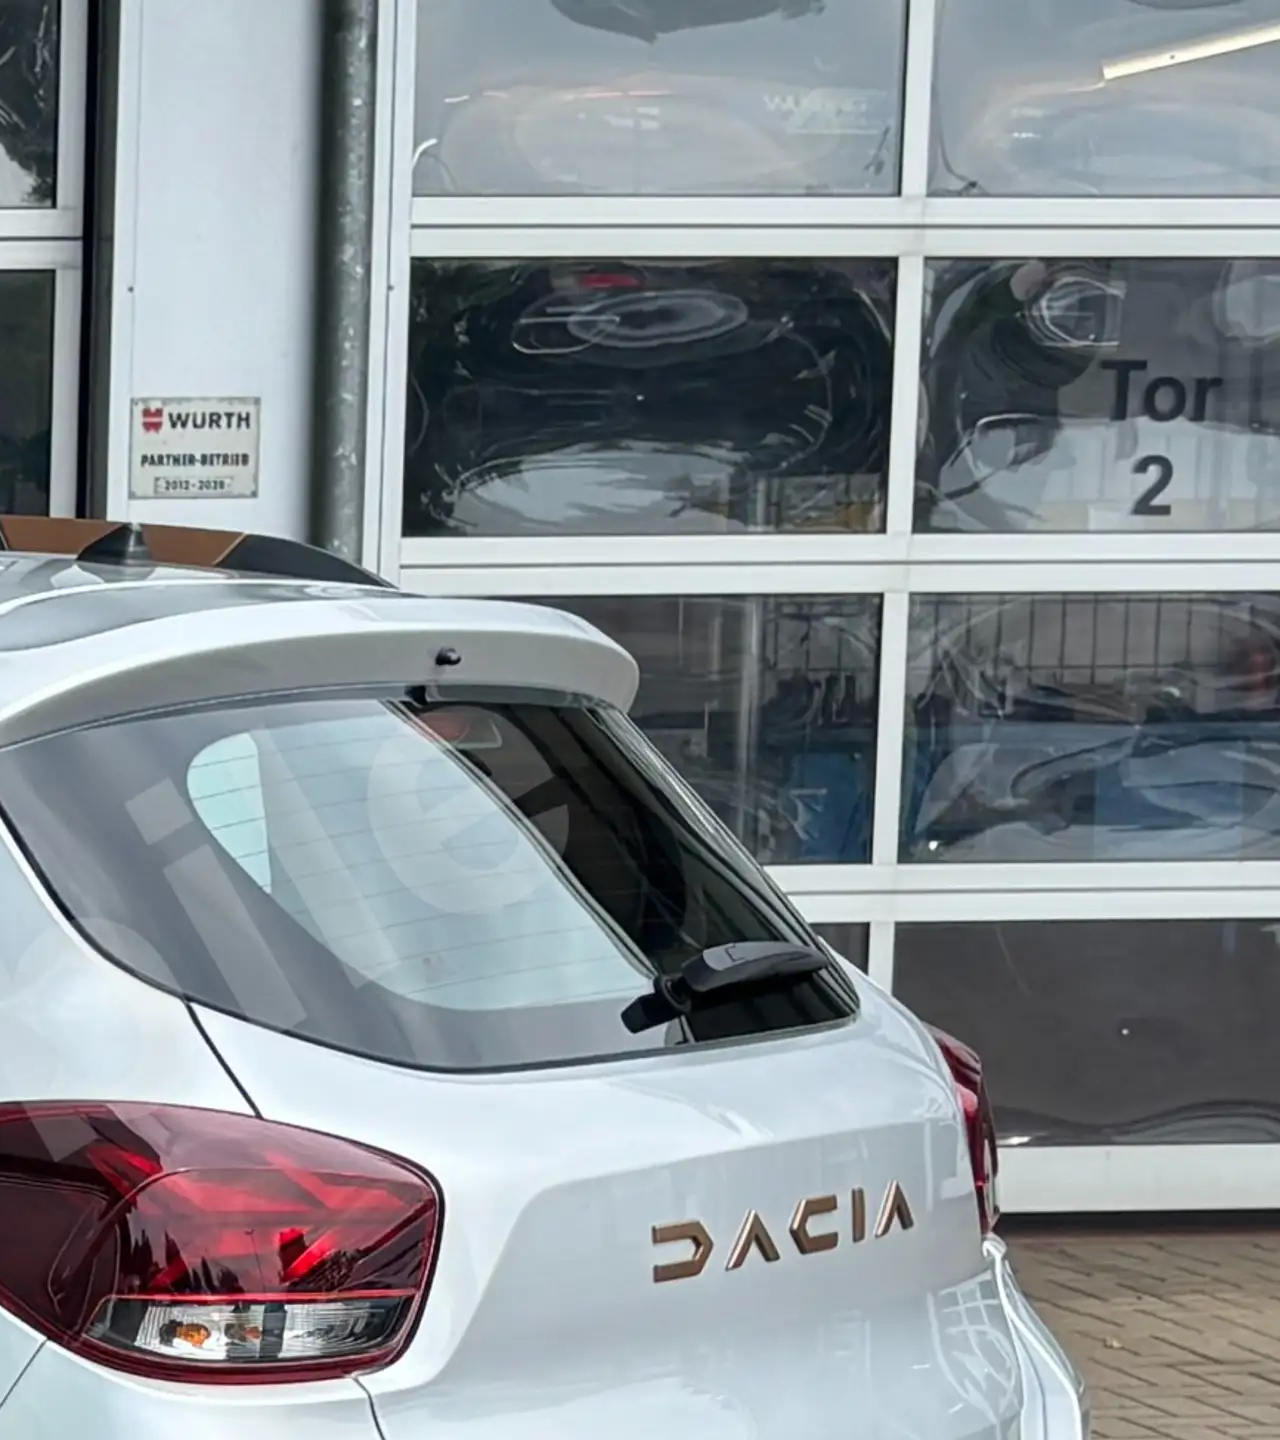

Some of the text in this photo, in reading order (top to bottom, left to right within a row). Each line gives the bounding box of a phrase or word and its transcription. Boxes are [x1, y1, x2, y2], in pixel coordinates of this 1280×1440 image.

[1100, 360, 1224, 422] Tor
[1130, 454, 1174, 516] 2
[652, 1179, 915, 1284] DACIA
